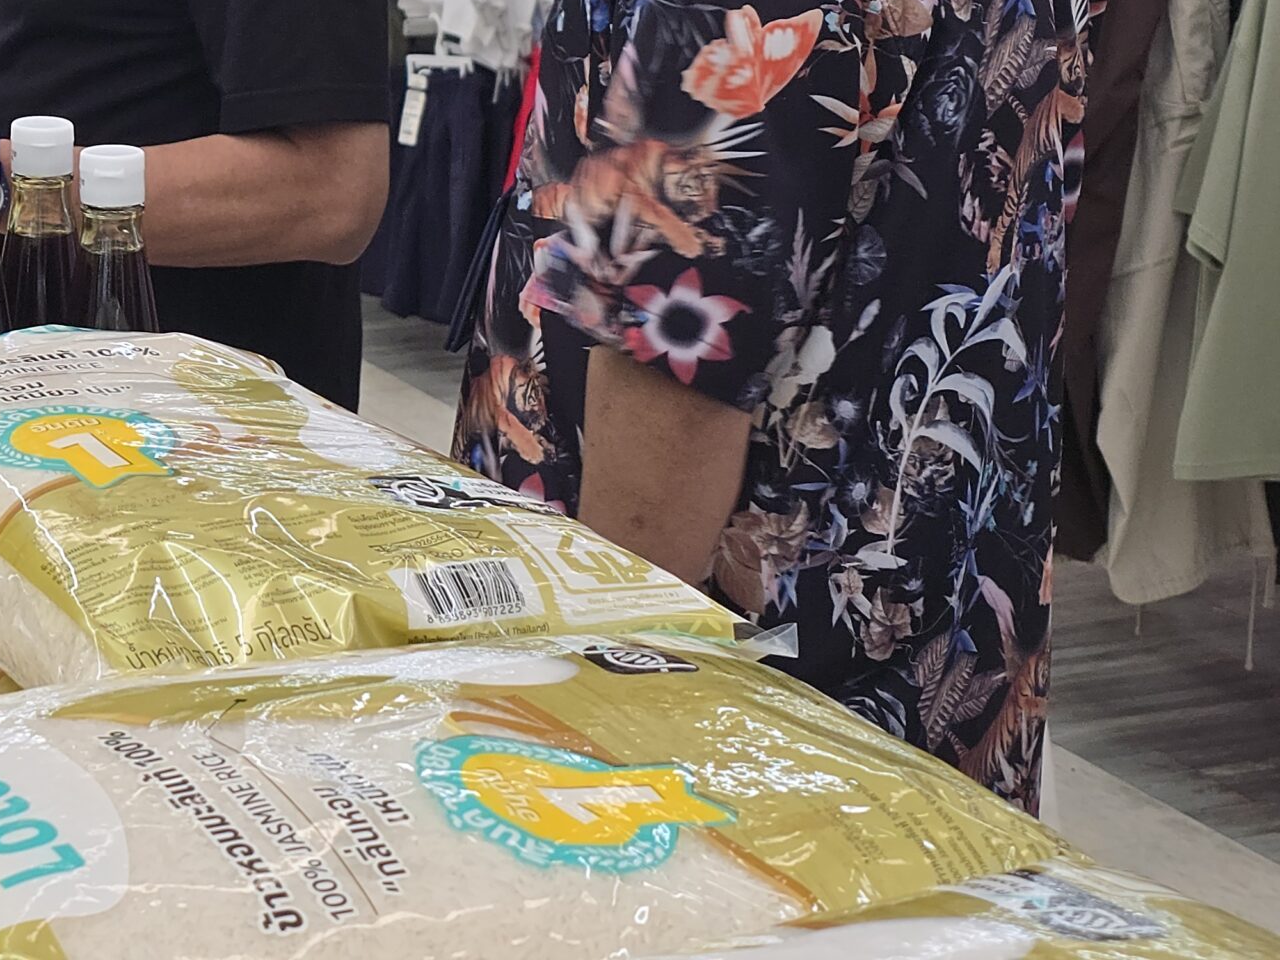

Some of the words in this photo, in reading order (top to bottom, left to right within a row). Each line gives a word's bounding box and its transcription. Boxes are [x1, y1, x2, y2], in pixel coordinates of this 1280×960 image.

[54, 361, 105, 373] RICE
[46, 431, 134, 469] 1
[98, 730, 165, 768] 100%
[192, 751, 242, 784] RICE
[228, 780, 312, 855] JASMINE
[536, 784, 666, 825] 1
[141, 767, 304, 932] ข้าวหอมมะลิแท้
[299, 858, 355, 921] 100%
